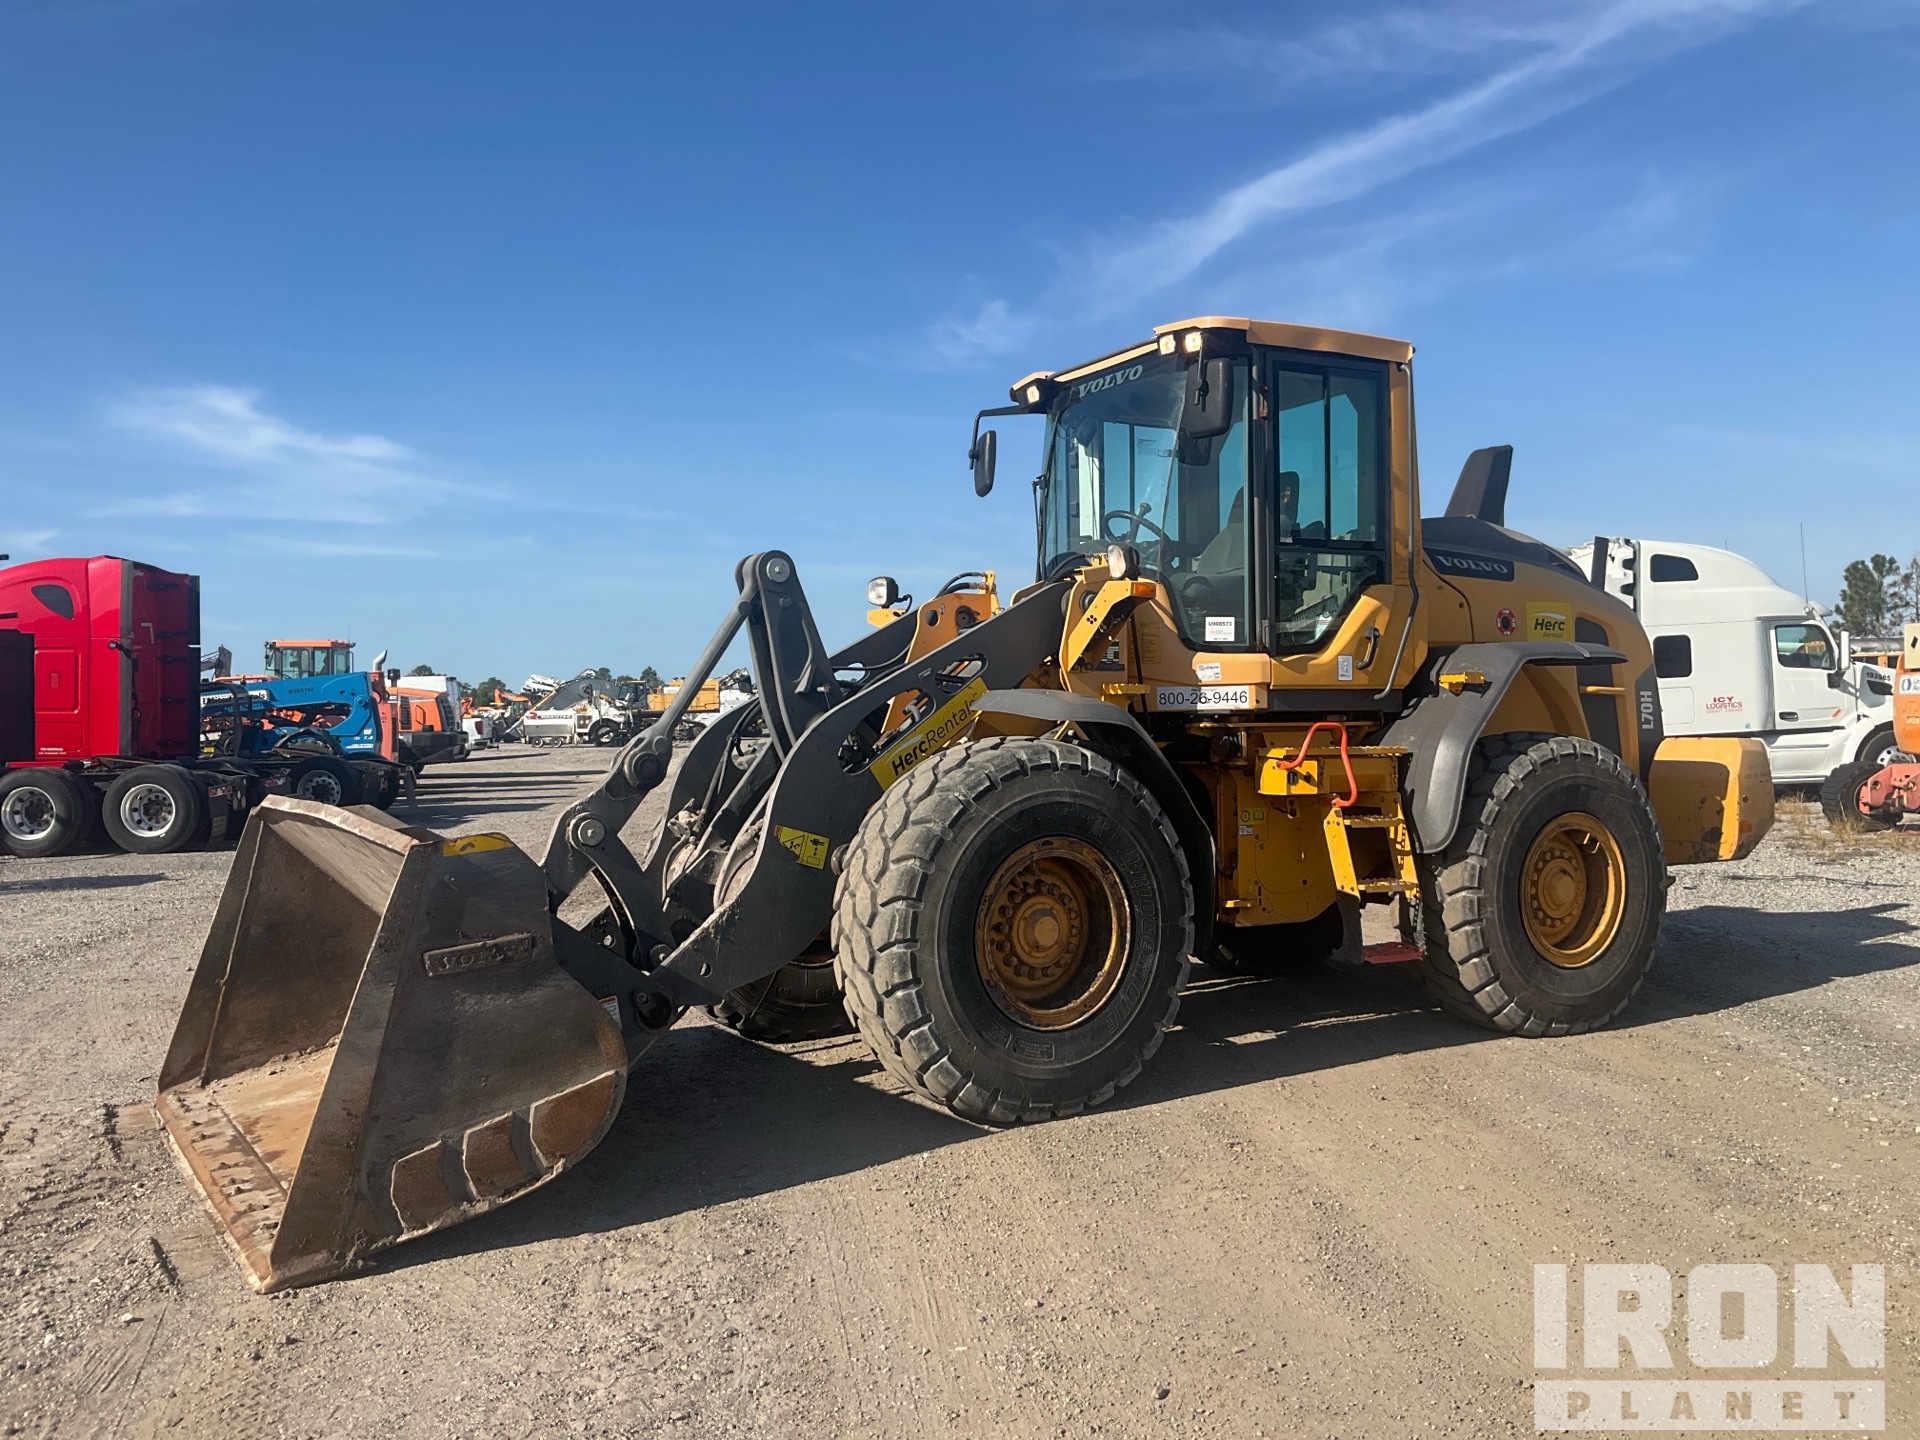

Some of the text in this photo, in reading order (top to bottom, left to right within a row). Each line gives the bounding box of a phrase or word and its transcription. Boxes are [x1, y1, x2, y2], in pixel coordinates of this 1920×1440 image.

[1078, 364, 1143, 398] VOLVO
[1435, 555, 1508, 574] VOLVO
[1534, 617, 1565, 631] Herc
[1158, 690, 1248, 705] 800-26-9446
[1713, 695, 1734, 703] ICY
[1640, 690, 1654, 729] L70H
[1705, 701, 1743, 710] LOGISTICS
